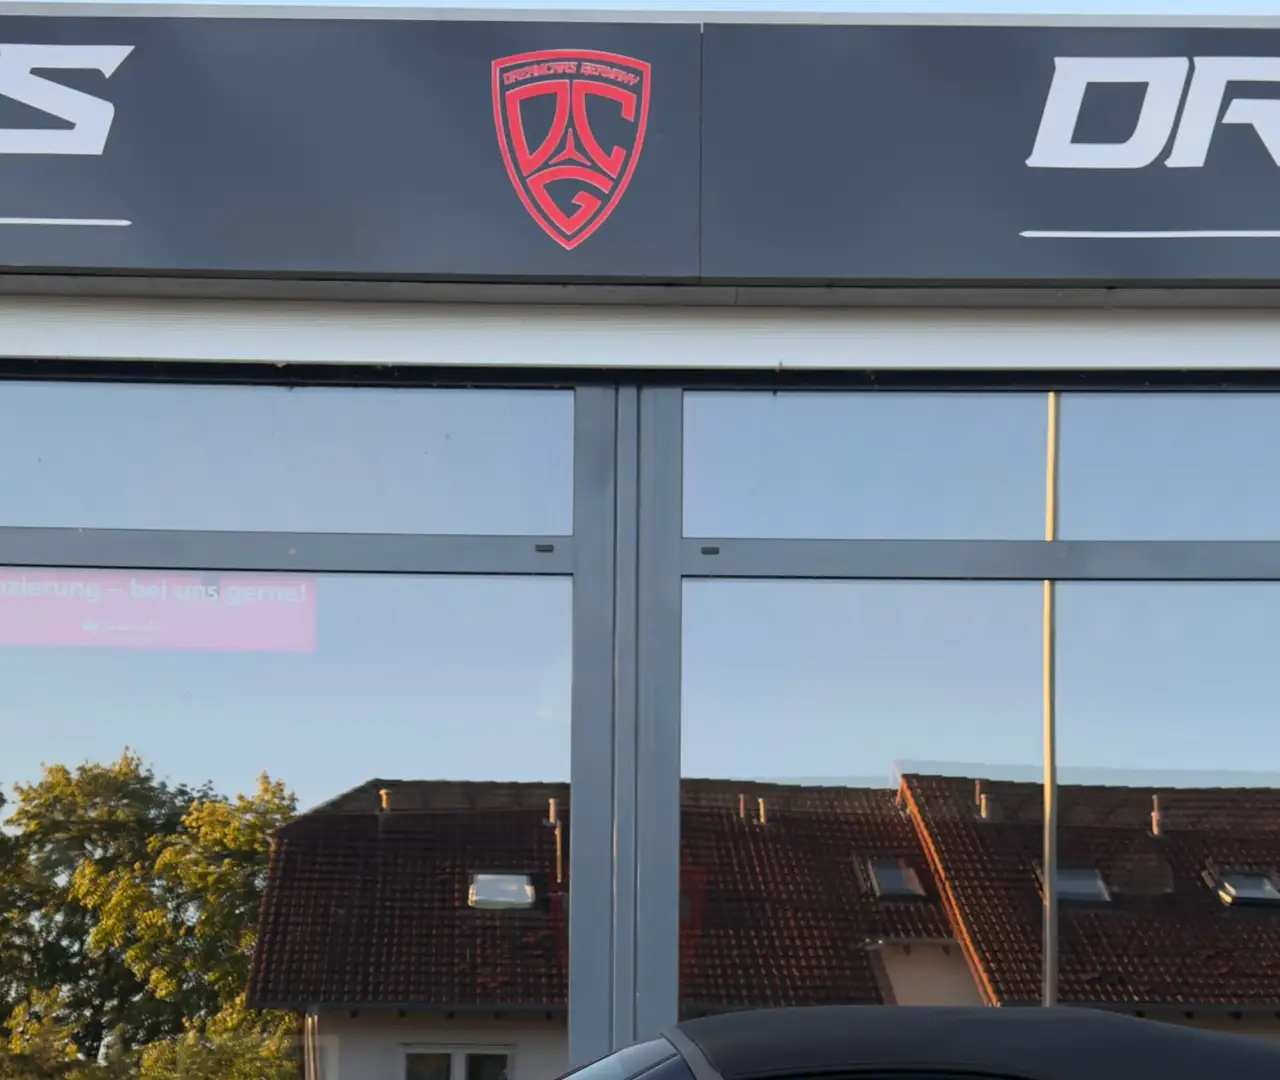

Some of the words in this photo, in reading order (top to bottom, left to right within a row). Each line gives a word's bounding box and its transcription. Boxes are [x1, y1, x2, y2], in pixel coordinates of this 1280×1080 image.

[130, 579, 167, 599] bei
[174, 585, 219, 600] uns
[225, 585, 308, 607] gerne!
